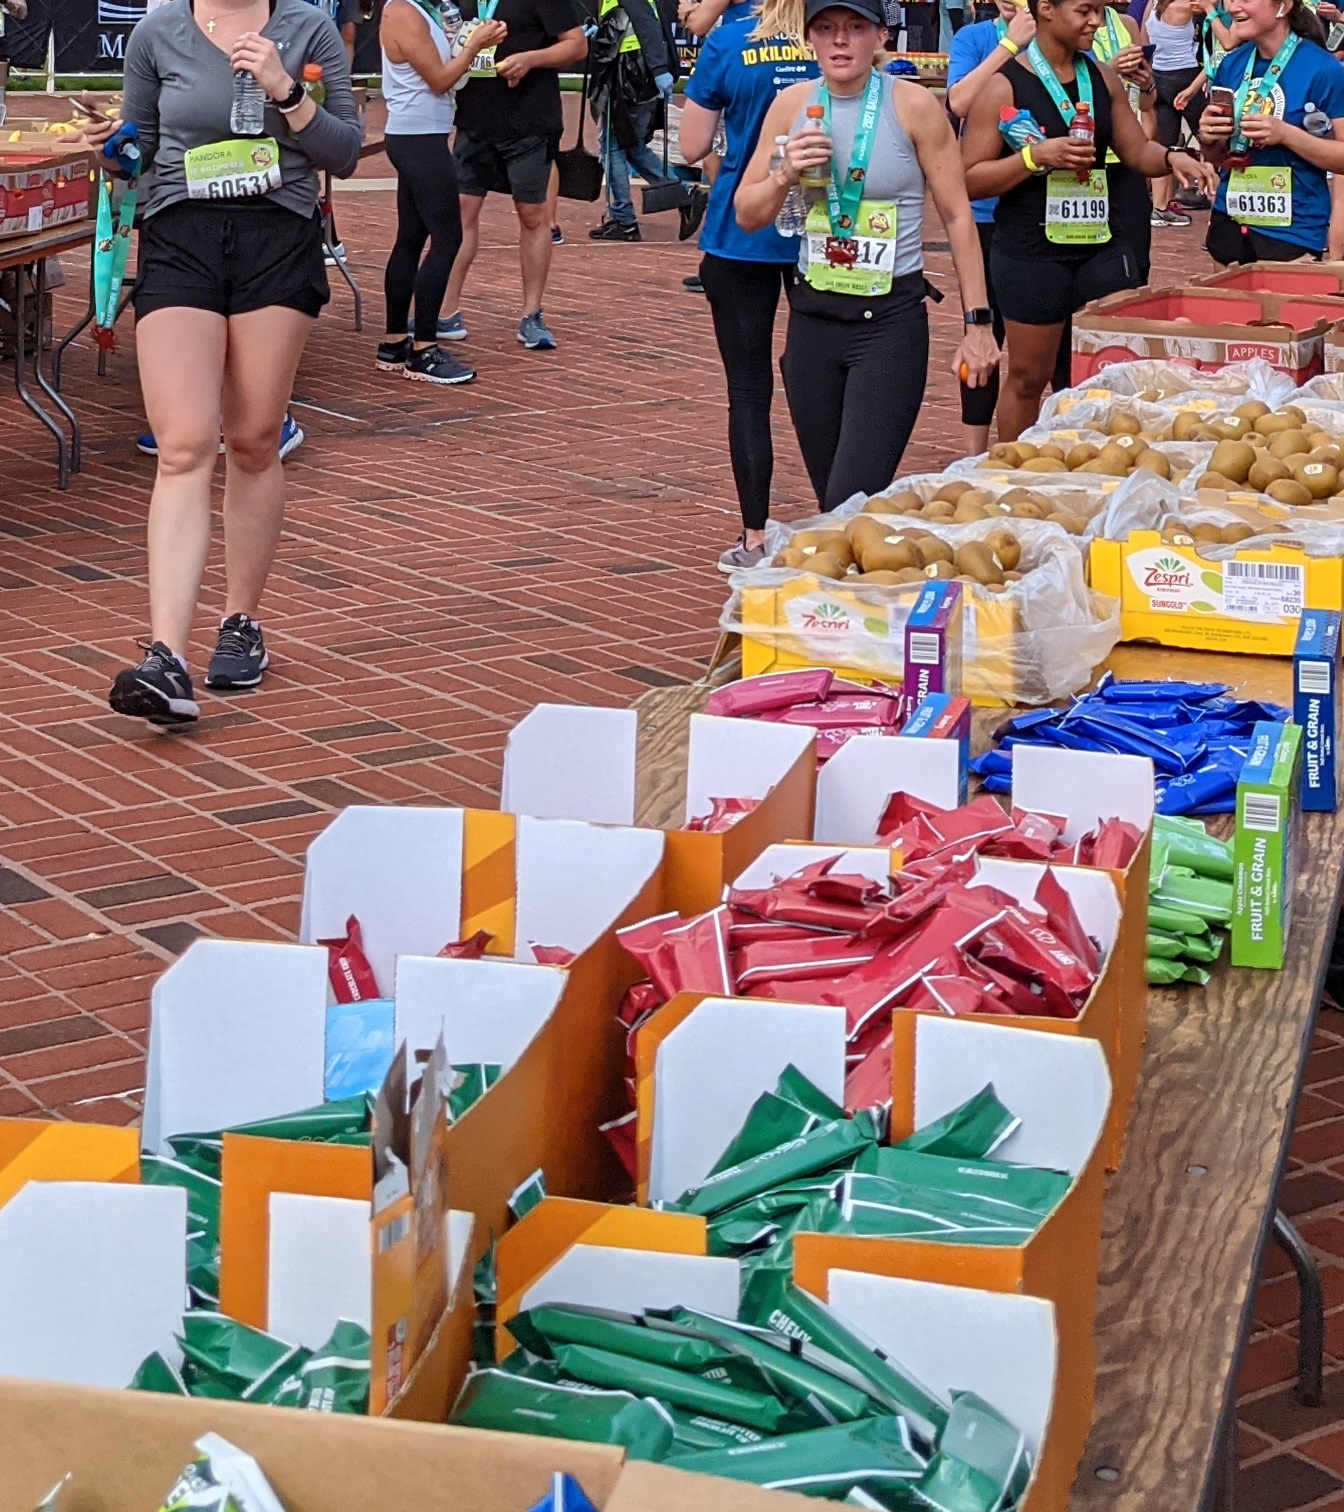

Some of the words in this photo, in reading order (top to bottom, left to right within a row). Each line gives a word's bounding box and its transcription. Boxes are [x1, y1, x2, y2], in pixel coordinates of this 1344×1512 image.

[741, 49, 757, 66] 10
[190, 151, 232, 163] PANDORA
[208, 172, 272, 199] 60531
[1061, 200, 1105, 219] 61199
[1239, 195, 1286, 213] 61363
[1232, 347, 1280, 361] APPLES
[1144, 567, 1191, 587] Zespri
[1283, 604, 1301, 614] 030
[1307, 699, 1321, 734] GRAIN
[1307, 738, 1318, 749] &
[1308, 755, 1321, 788] FRUIT
[1251, 838, 1267, 882] GRAIN
[1251, 884, 1262, 897] &
[1251, 904, 1263, 941] FRUIT
[767, 1309, 812, 1343] CHEWY
